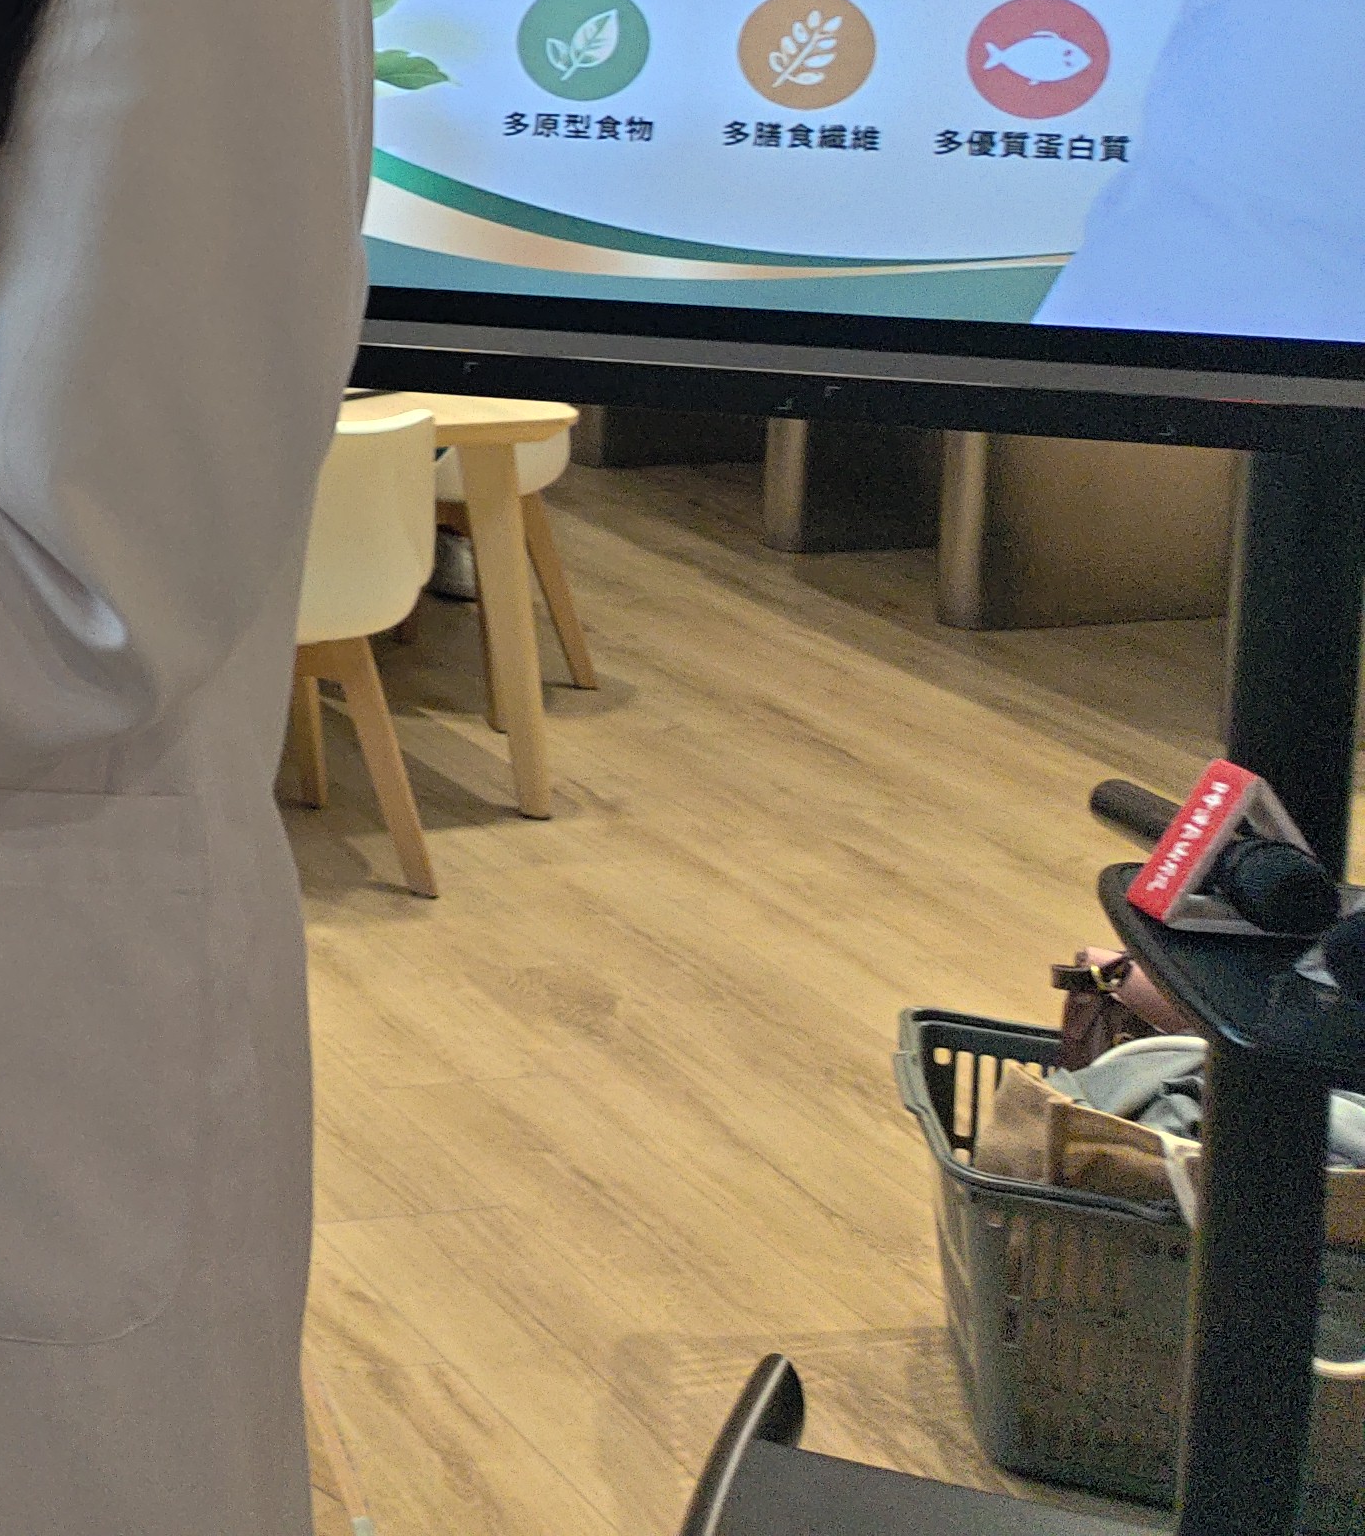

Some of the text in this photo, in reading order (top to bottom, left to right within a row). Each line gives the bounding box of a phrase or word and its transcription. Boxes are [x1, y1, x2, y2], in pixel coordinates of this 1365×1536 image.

[502, 112, 654, 143] 多原型食物
[722, 120, 881, 153] 多膳食纖維
[933, 129, 1131, 164] 多優質蛋白質
